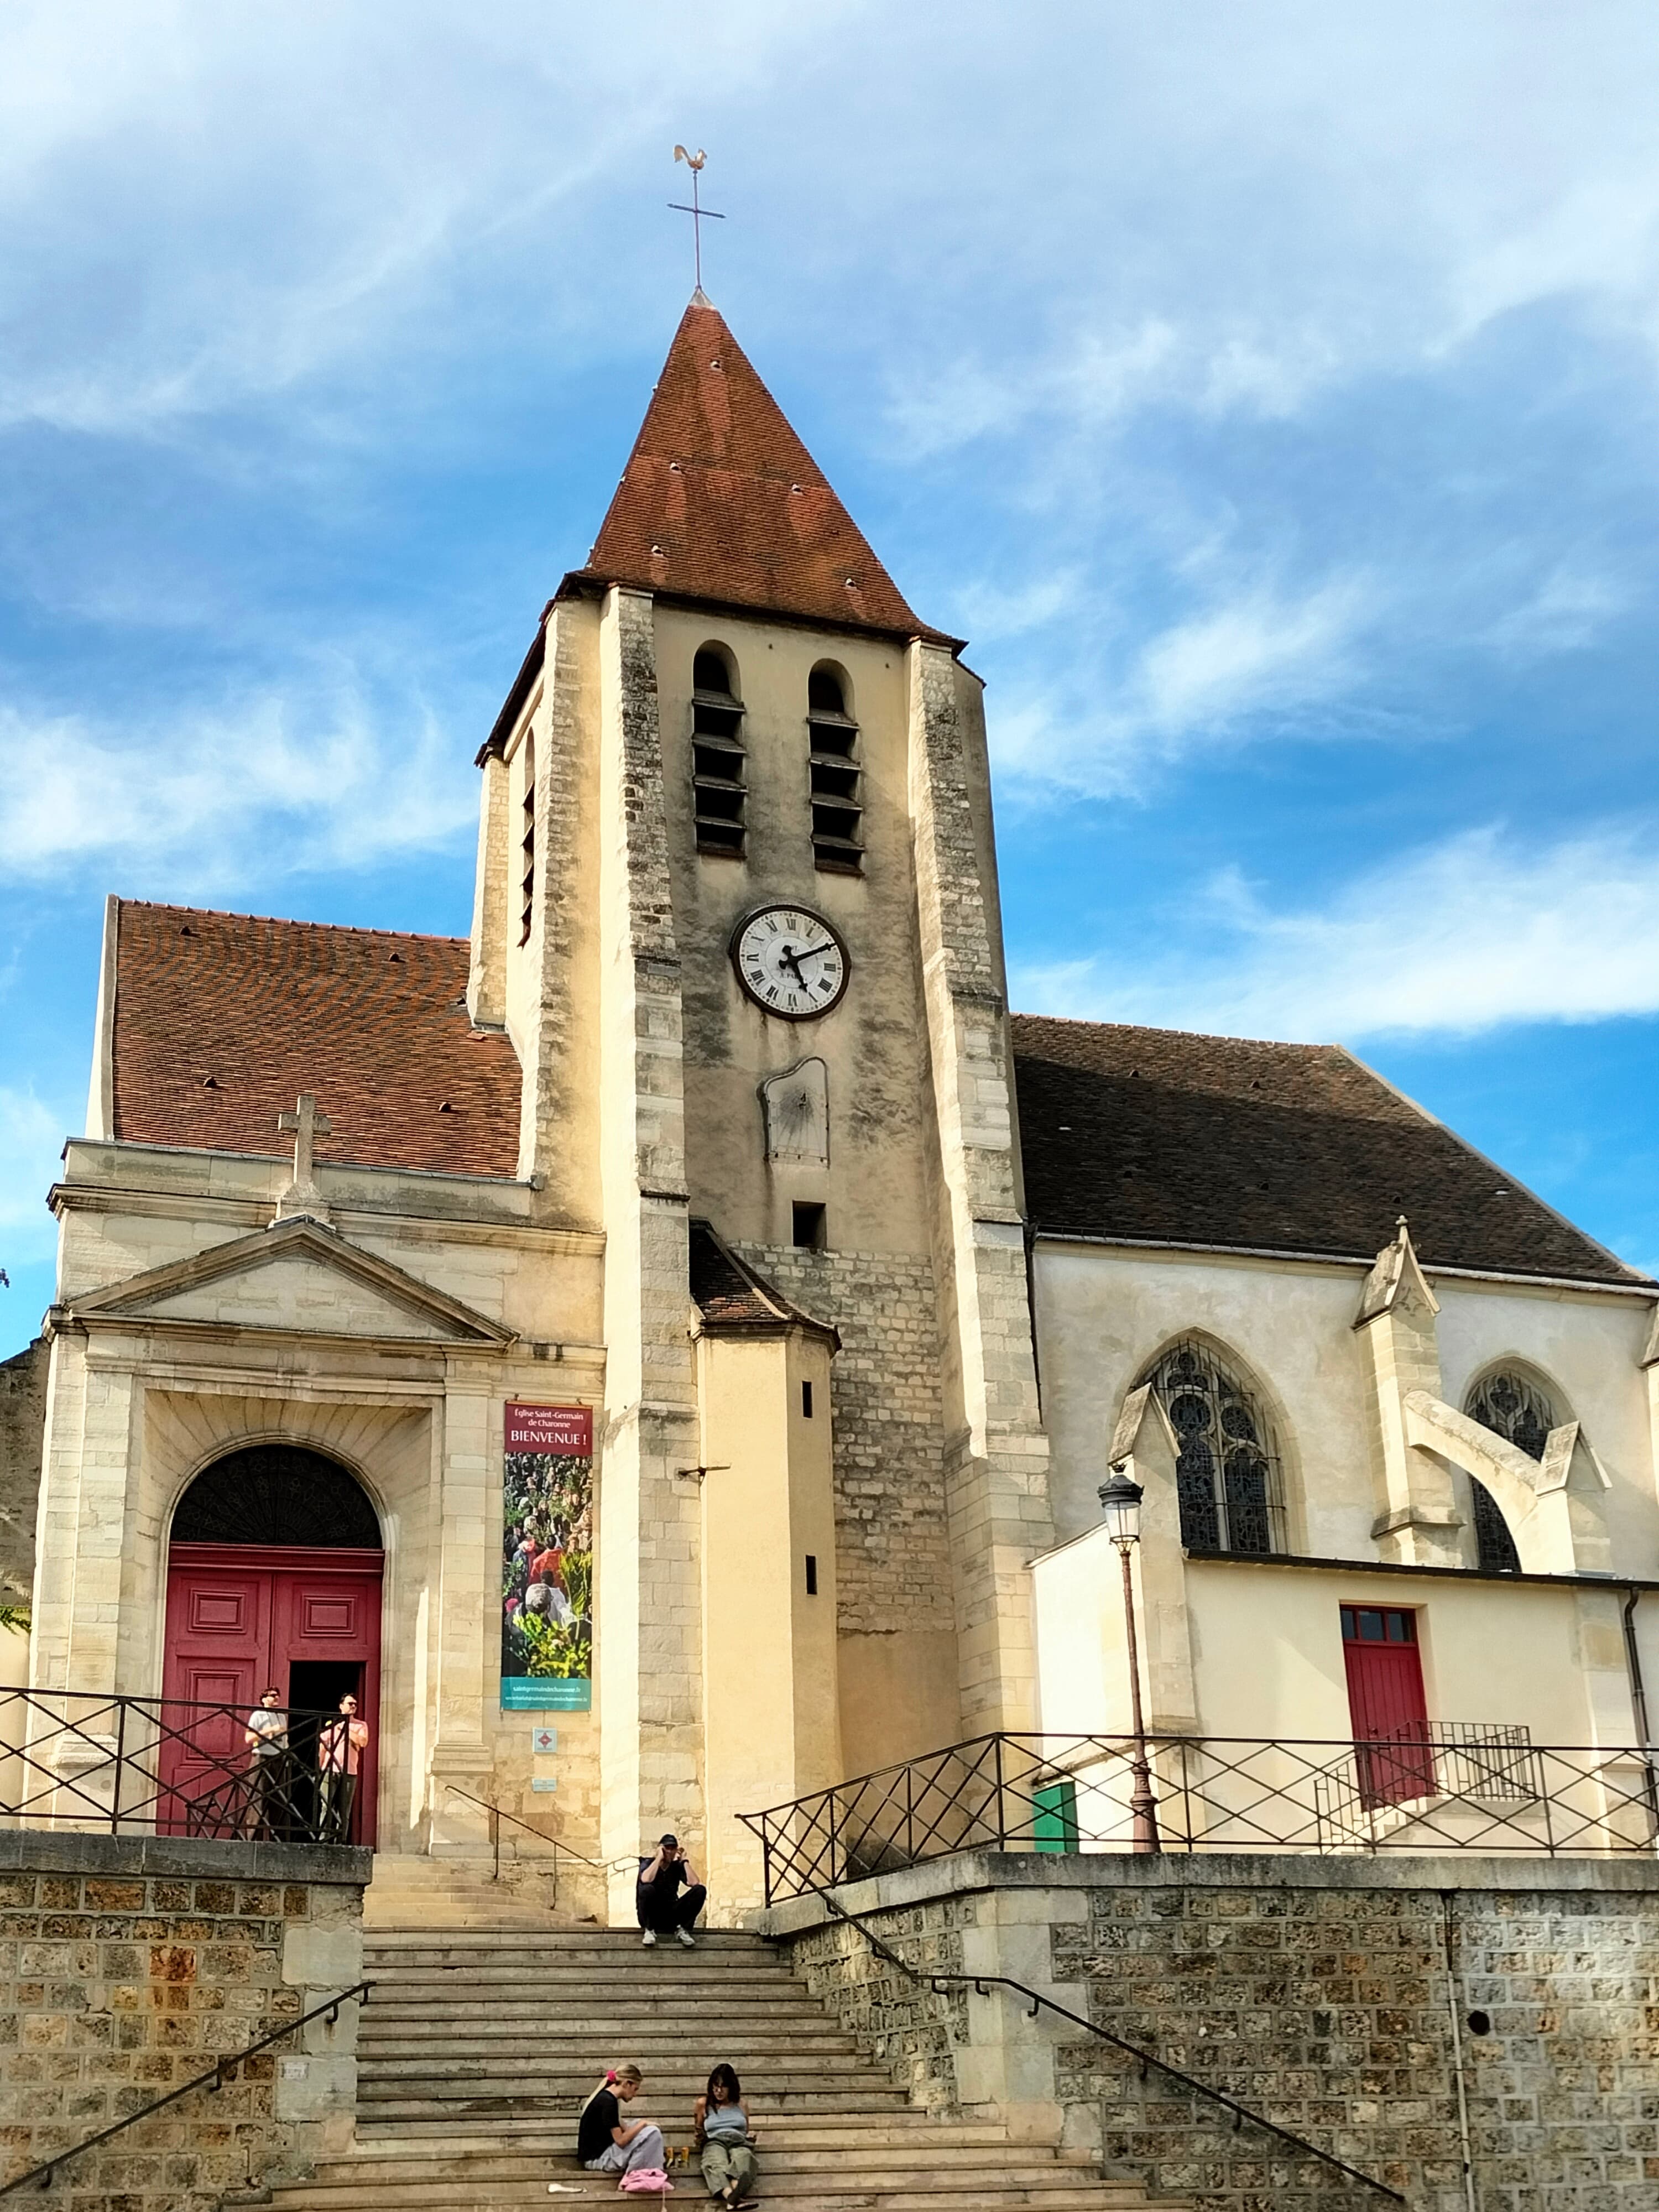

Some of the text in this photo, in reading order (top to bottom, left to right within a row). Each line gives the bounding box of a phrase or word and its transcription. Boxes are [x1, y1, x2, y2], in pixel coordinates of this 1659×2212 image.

[535, 1411, 584, 1420] Saint-Germain
[538, 1420, 571, 1428] Charonne
[511, 1430, 587, 1445] BIENVENUE !
